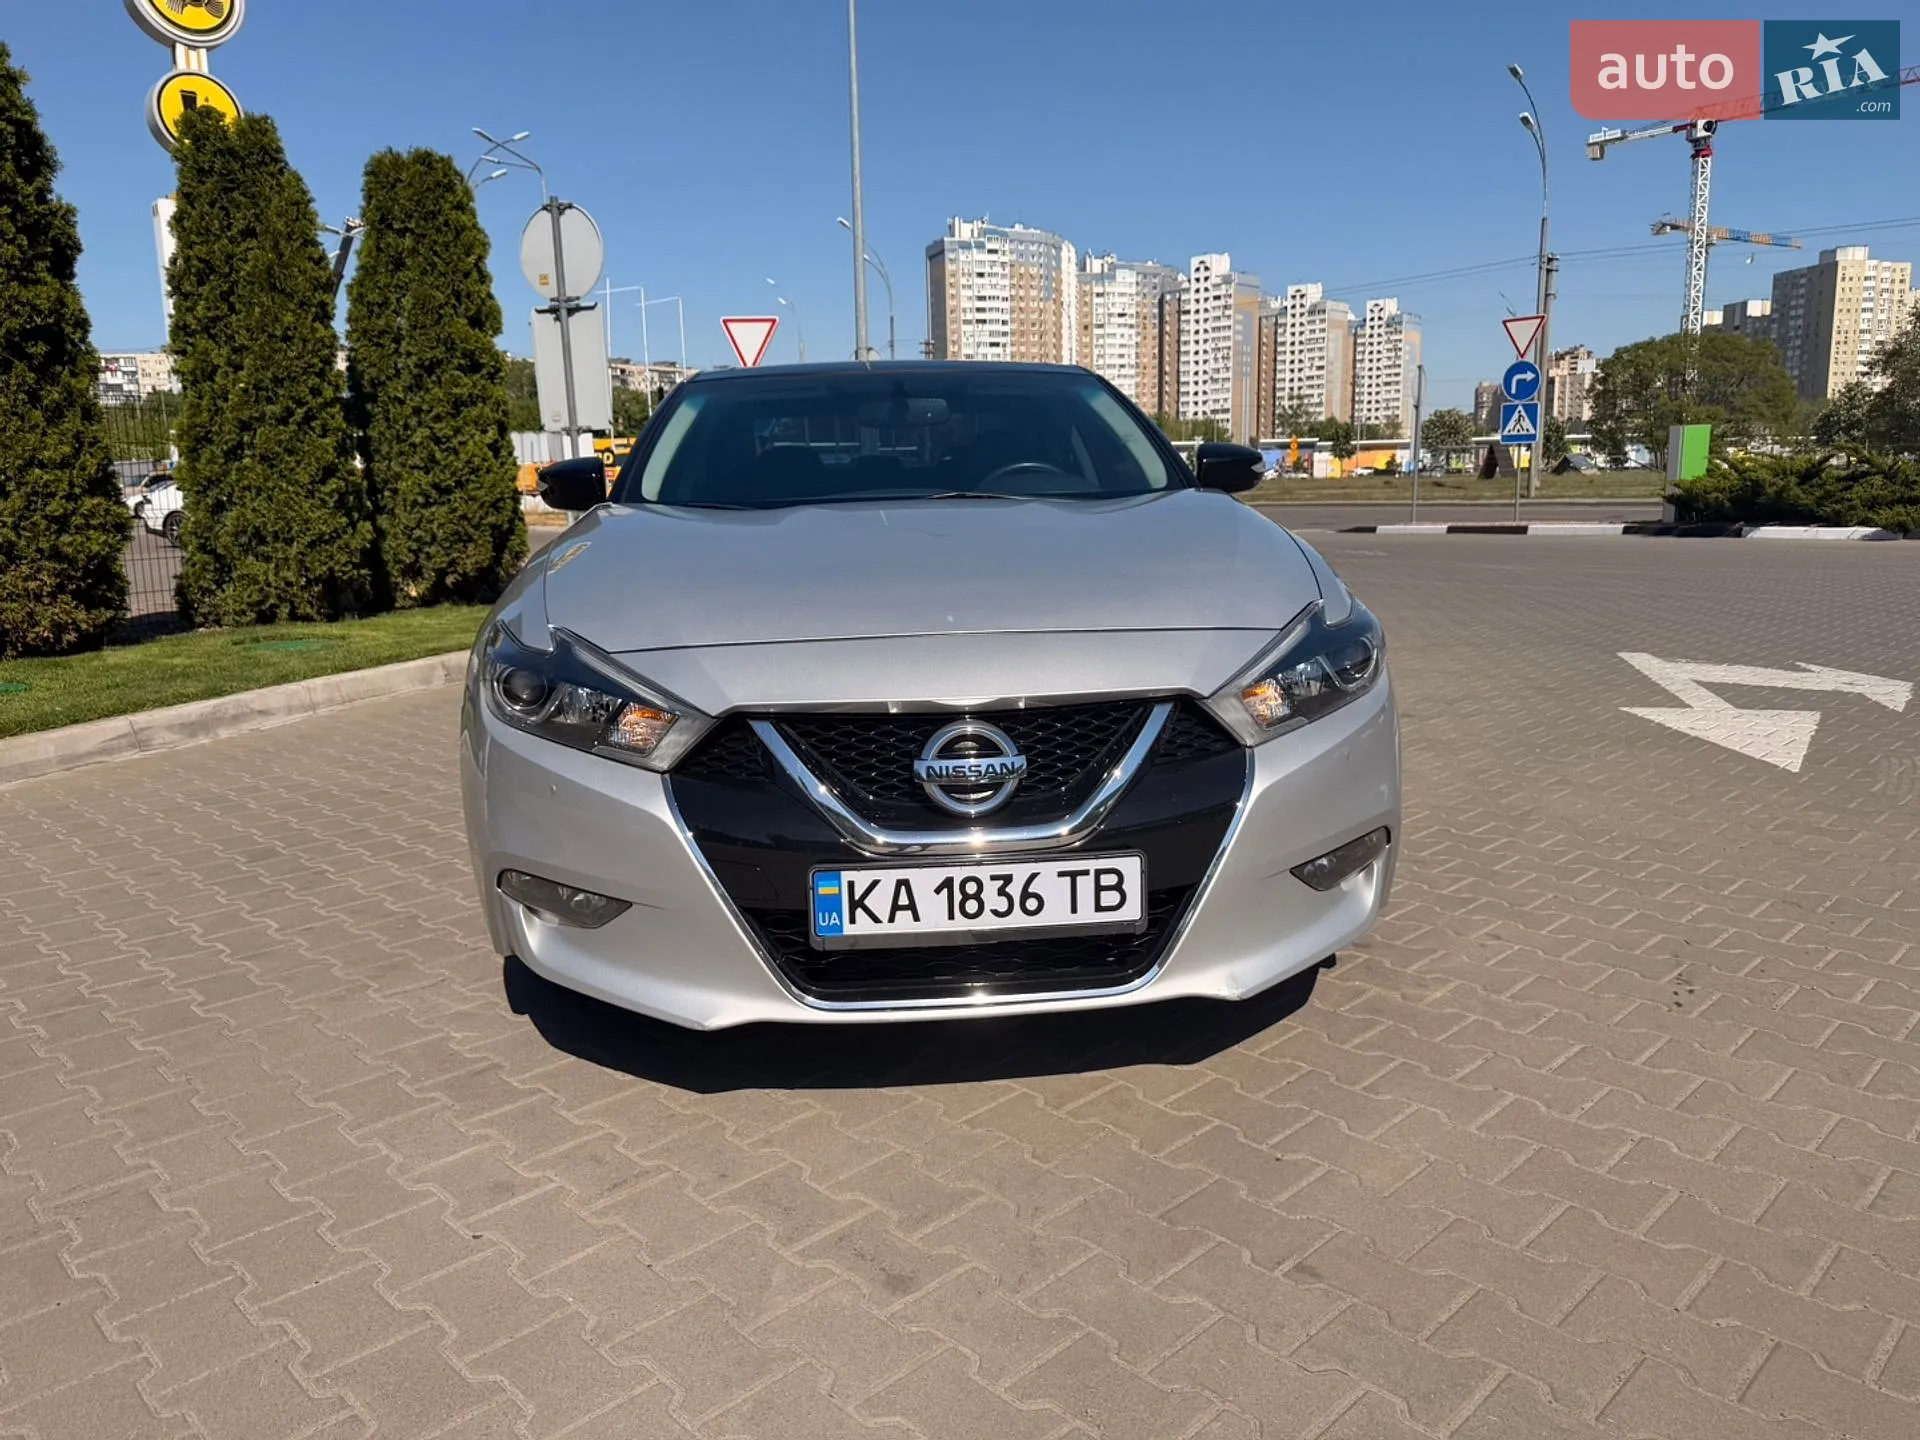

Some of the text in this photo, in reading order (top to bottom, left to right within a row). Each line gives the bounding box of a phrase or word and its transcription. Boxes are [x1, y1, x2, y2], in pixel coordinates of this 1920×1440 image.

[925, 761, 1016, 779] NISSAN
[846, 867, 1128, 925] KA 1836 TB
[818, 912, 841, 927] UA
